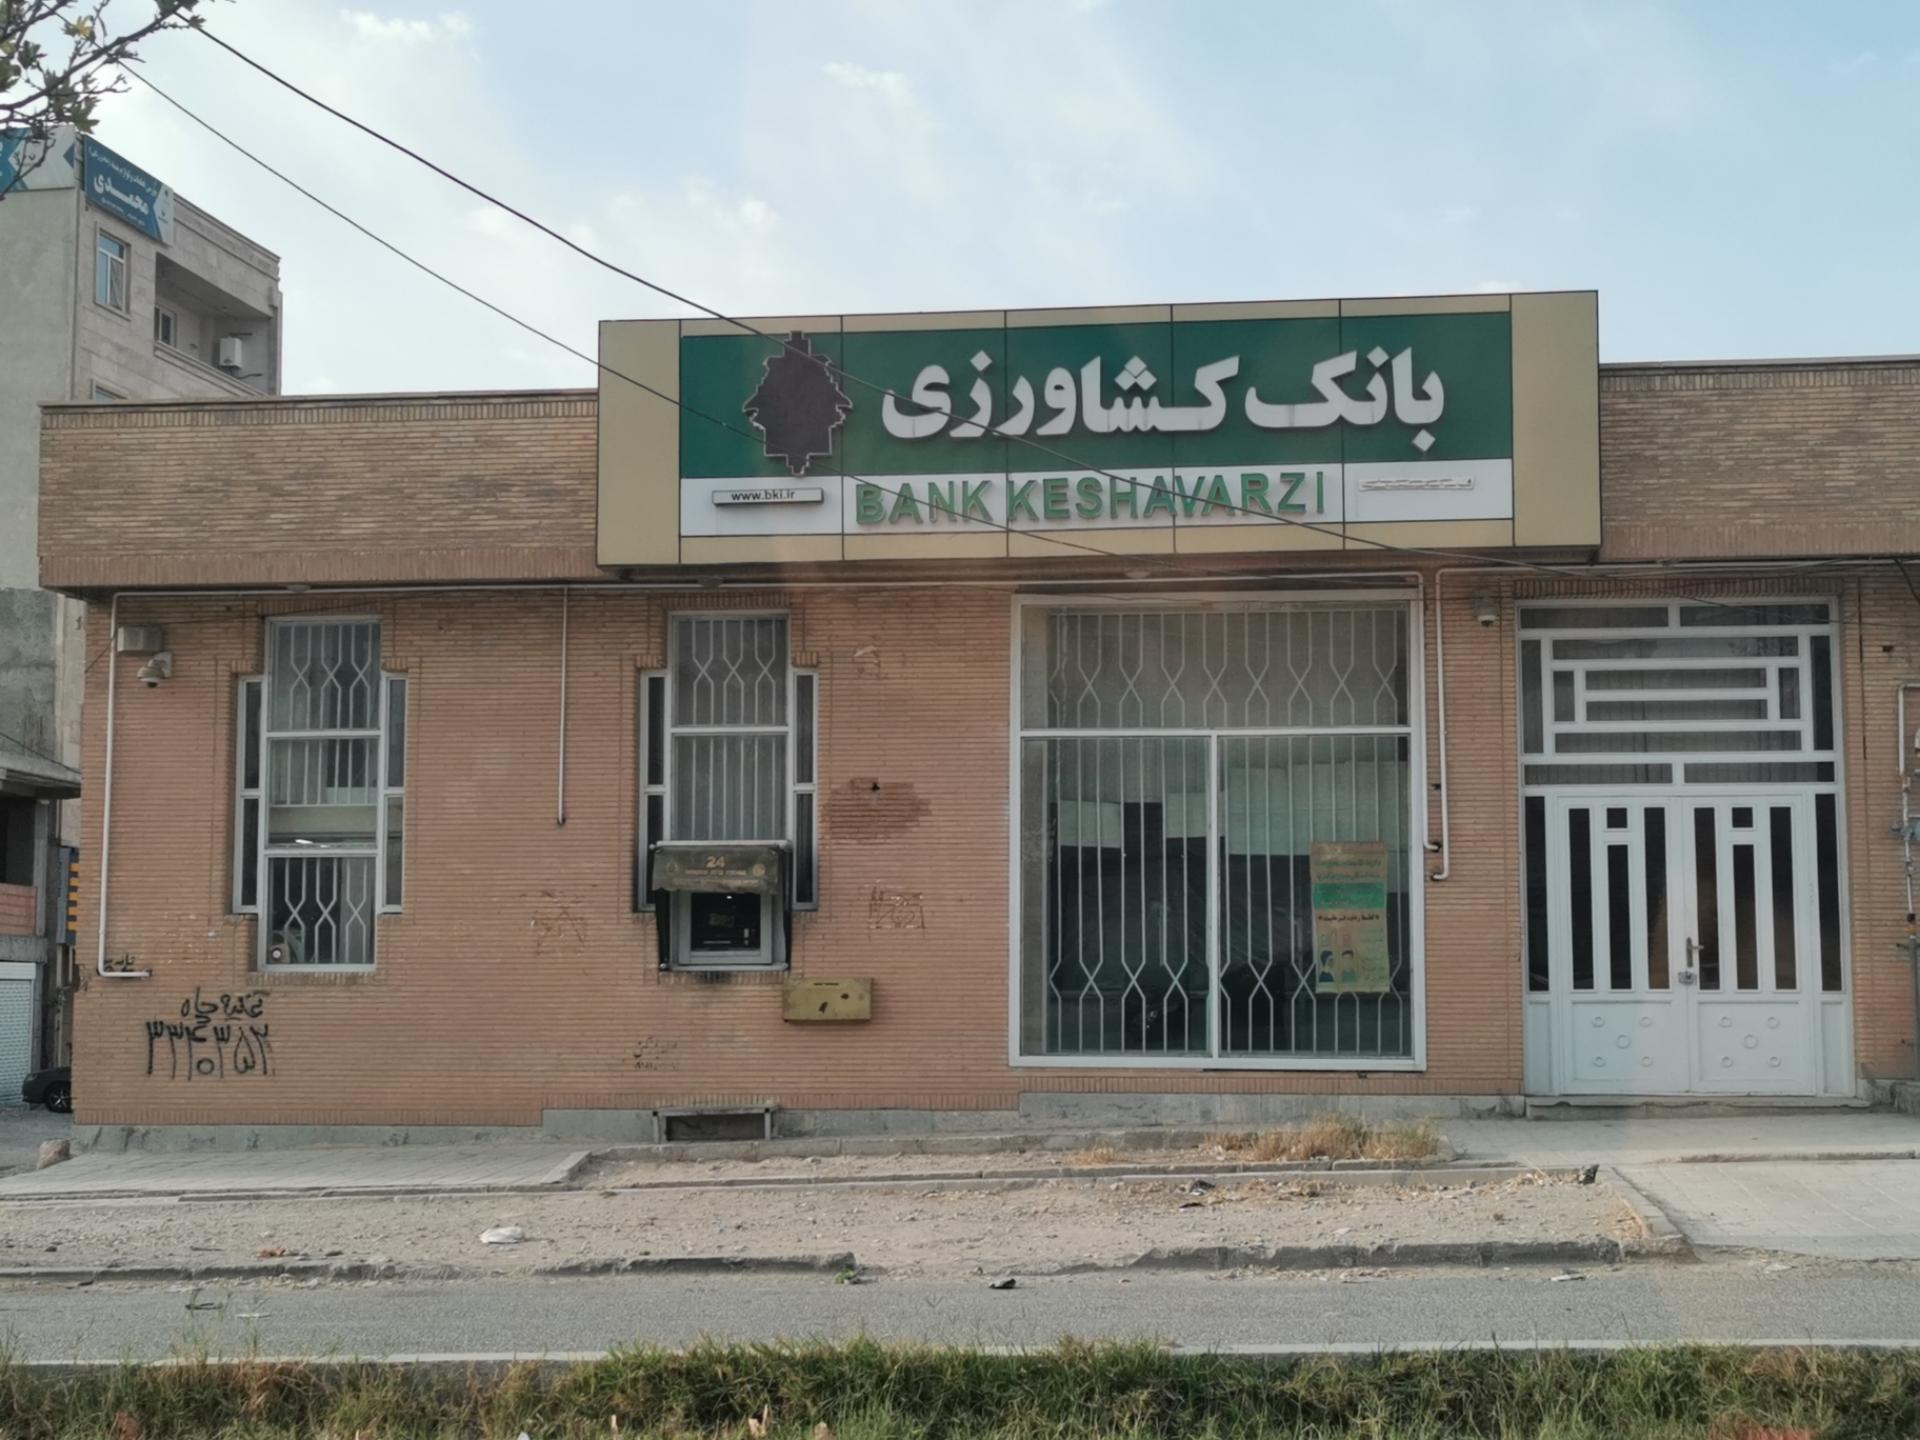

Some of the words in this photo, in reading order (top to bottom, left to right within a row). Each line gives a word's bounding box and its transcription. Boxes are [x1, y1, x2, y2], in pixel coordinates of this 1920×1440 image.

[882, 350, 1239, 438] کشاورزی
[1245, 346, 1444, 452] بانک
[731, 490, 795, 501] www.bki.ir
[856, 480, 993, 524] BANK
[1008, 472, 1325, 520] KESHAVARZI
[706, 855, 726, 868] 24
